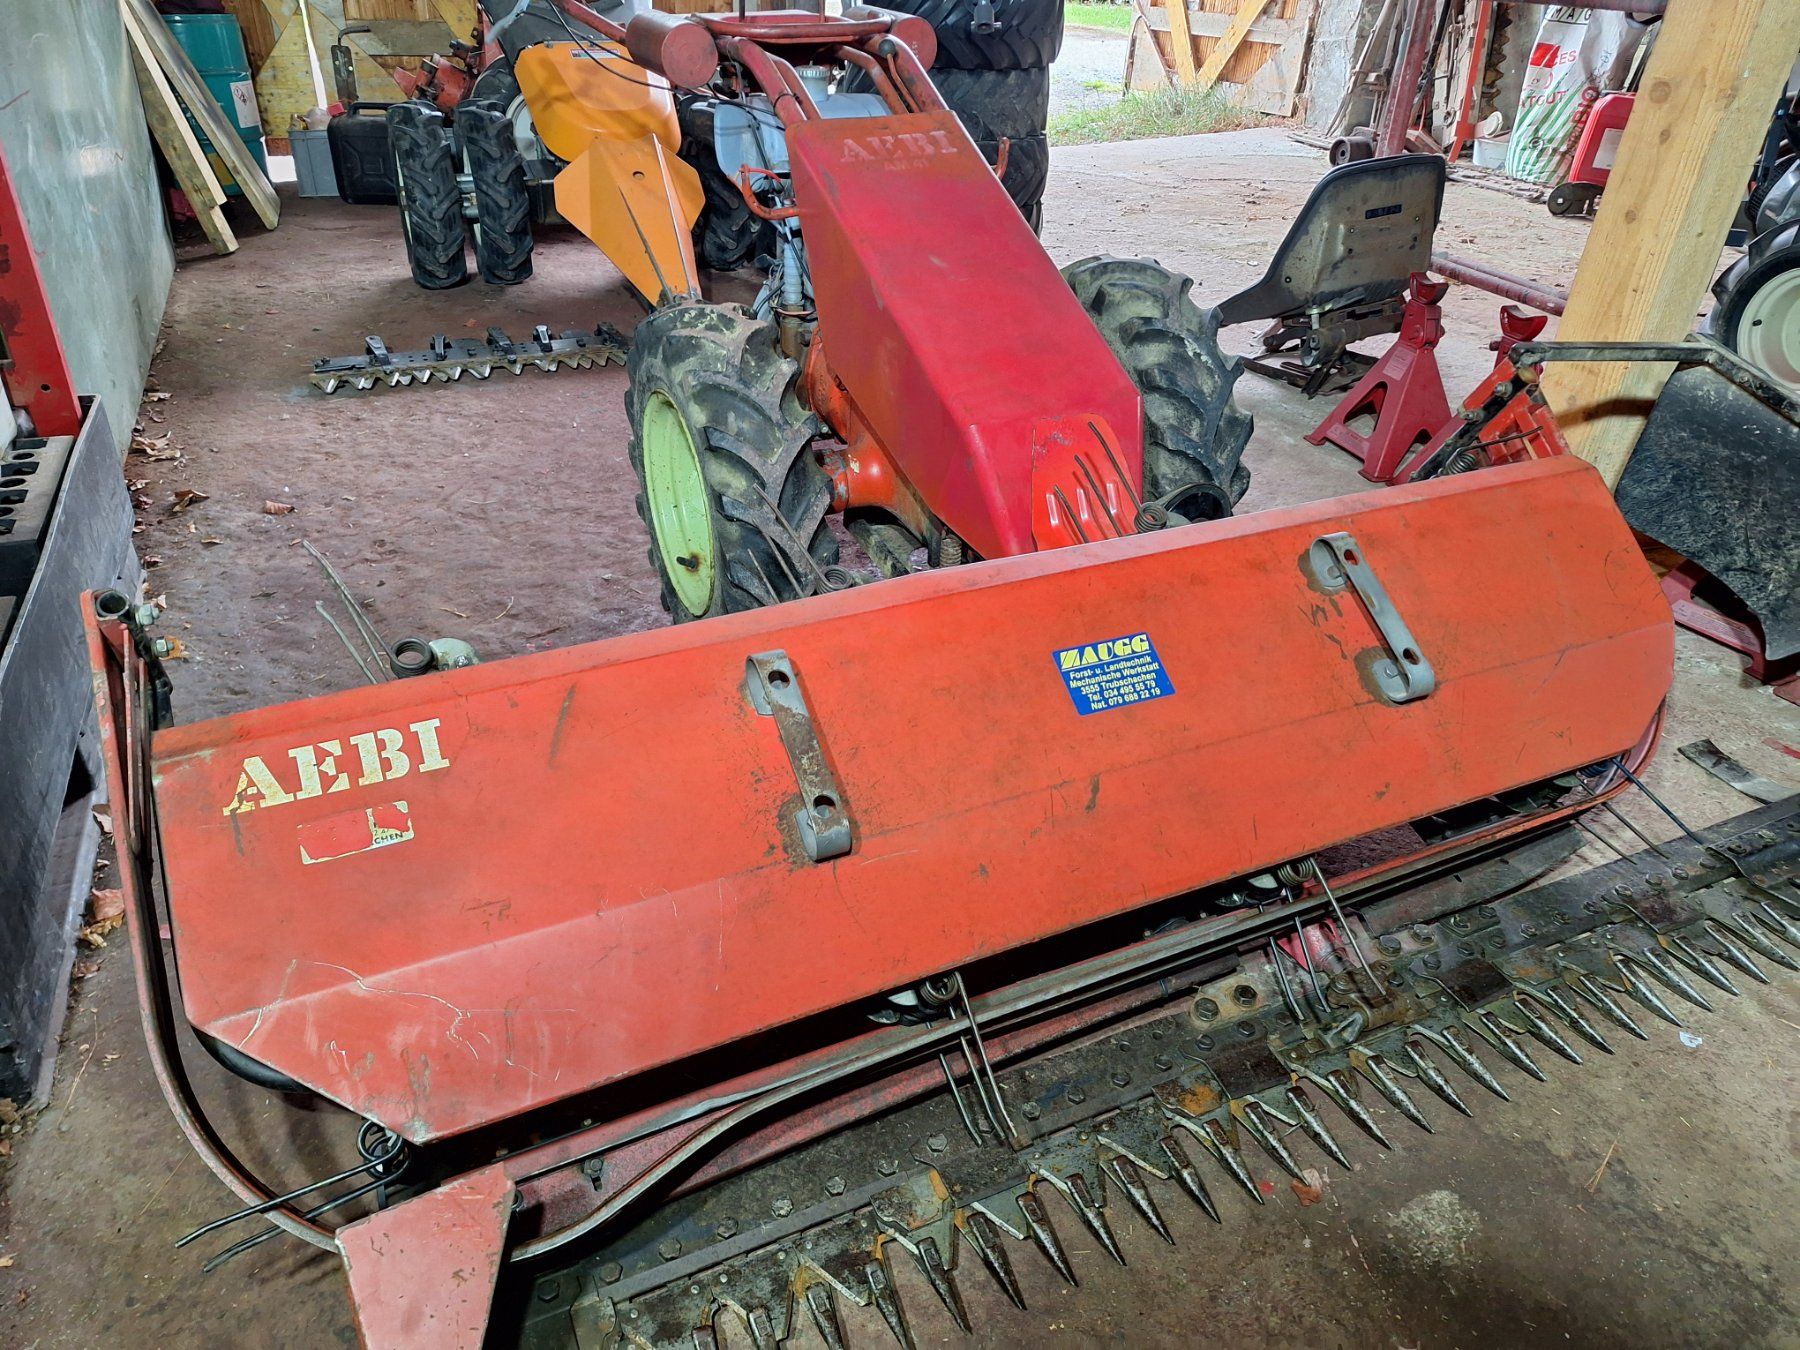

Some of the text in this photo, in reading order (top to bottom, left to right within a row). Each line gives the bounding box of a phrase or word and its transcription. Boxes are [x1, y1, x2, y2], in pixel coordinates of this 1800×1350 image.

[840, 130, 958, 161] AEBI
[1060, 634, 1149, 669] ZAUGG
[1070, 668, 1094, 680] Forst-
[1104, 655, 1152, 672] Landtechnik
[1070, 662, 1160, 688] Mechanische Werkstatt
[1081, 672, 1156, 695] 3555 Trubschachen
[1088, 680, 1156, 702] Tel. 034 495 55 79
[1091, 700, 1108, 710] Nat.
[1109, 696, 1123, 706] 079
[1140, 690, 1150, 699] 22
[1151, 687, 1161, 696] 19
[222, 718, 450, 816] AEBI
